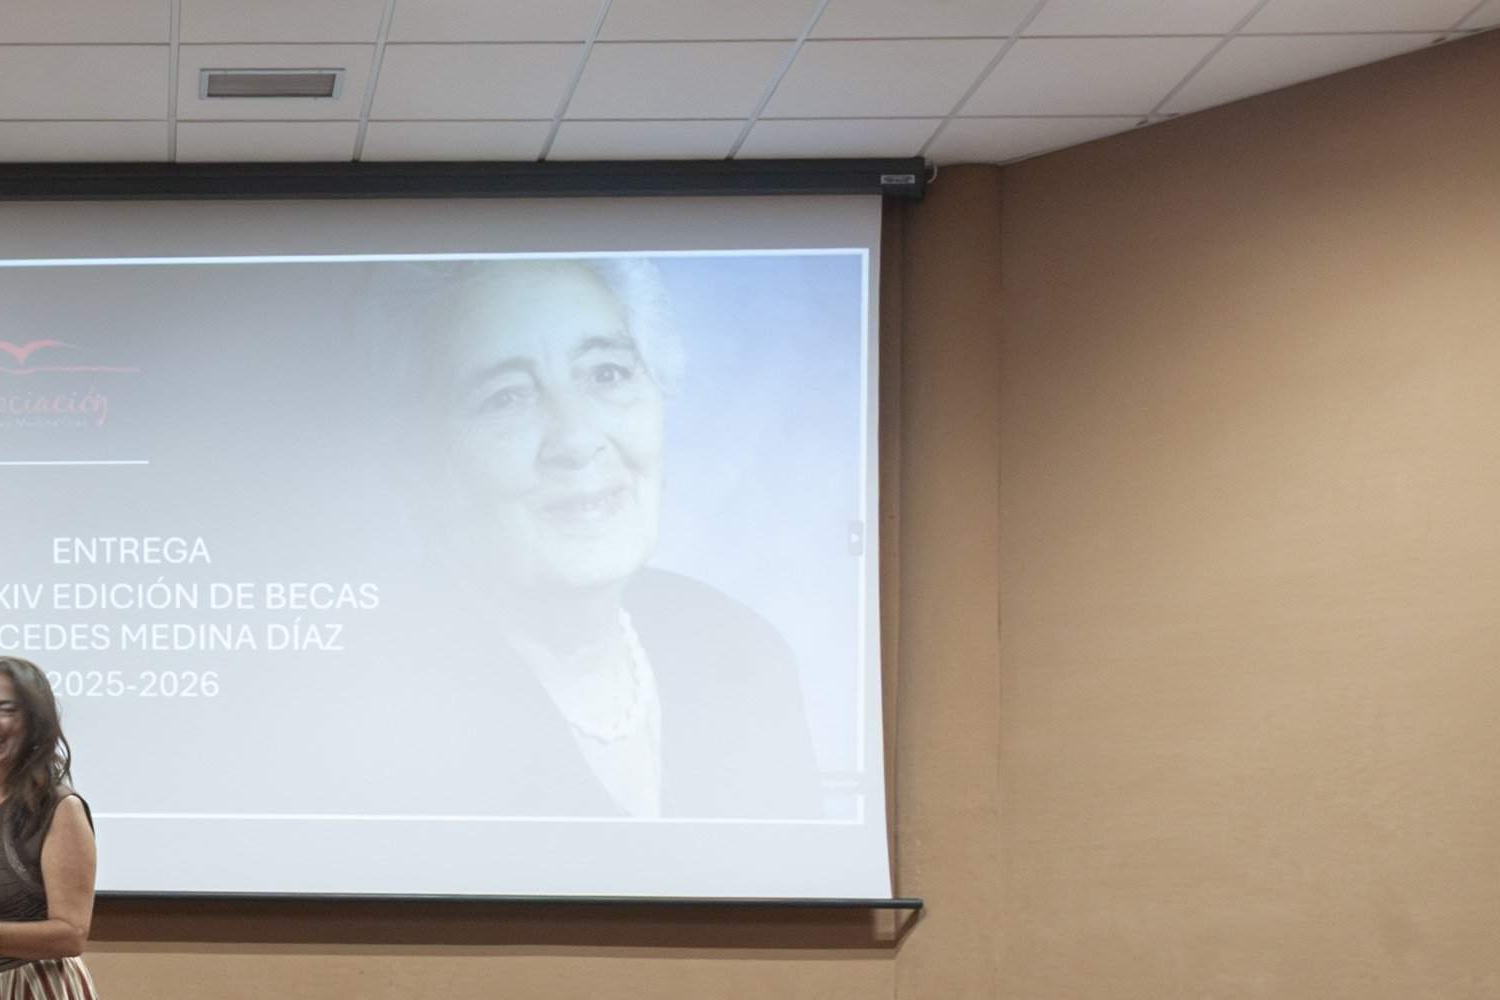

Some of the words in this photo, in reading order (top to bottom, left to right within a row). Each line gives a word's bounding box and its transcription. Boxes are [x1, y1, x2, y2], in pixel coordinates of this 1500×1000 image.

[52, 536, 212, 565] ENTREGA
[52, 576, 200, 611] EDICIÓN
[210, 582, 255, 610] DE
[265, 581, 380, 611] BECAS
[121, 623, 258, 651] MEDINA
[267, 617, 344, 651] DÍAZ
[50, 671, 220, 698] 2025-2026
